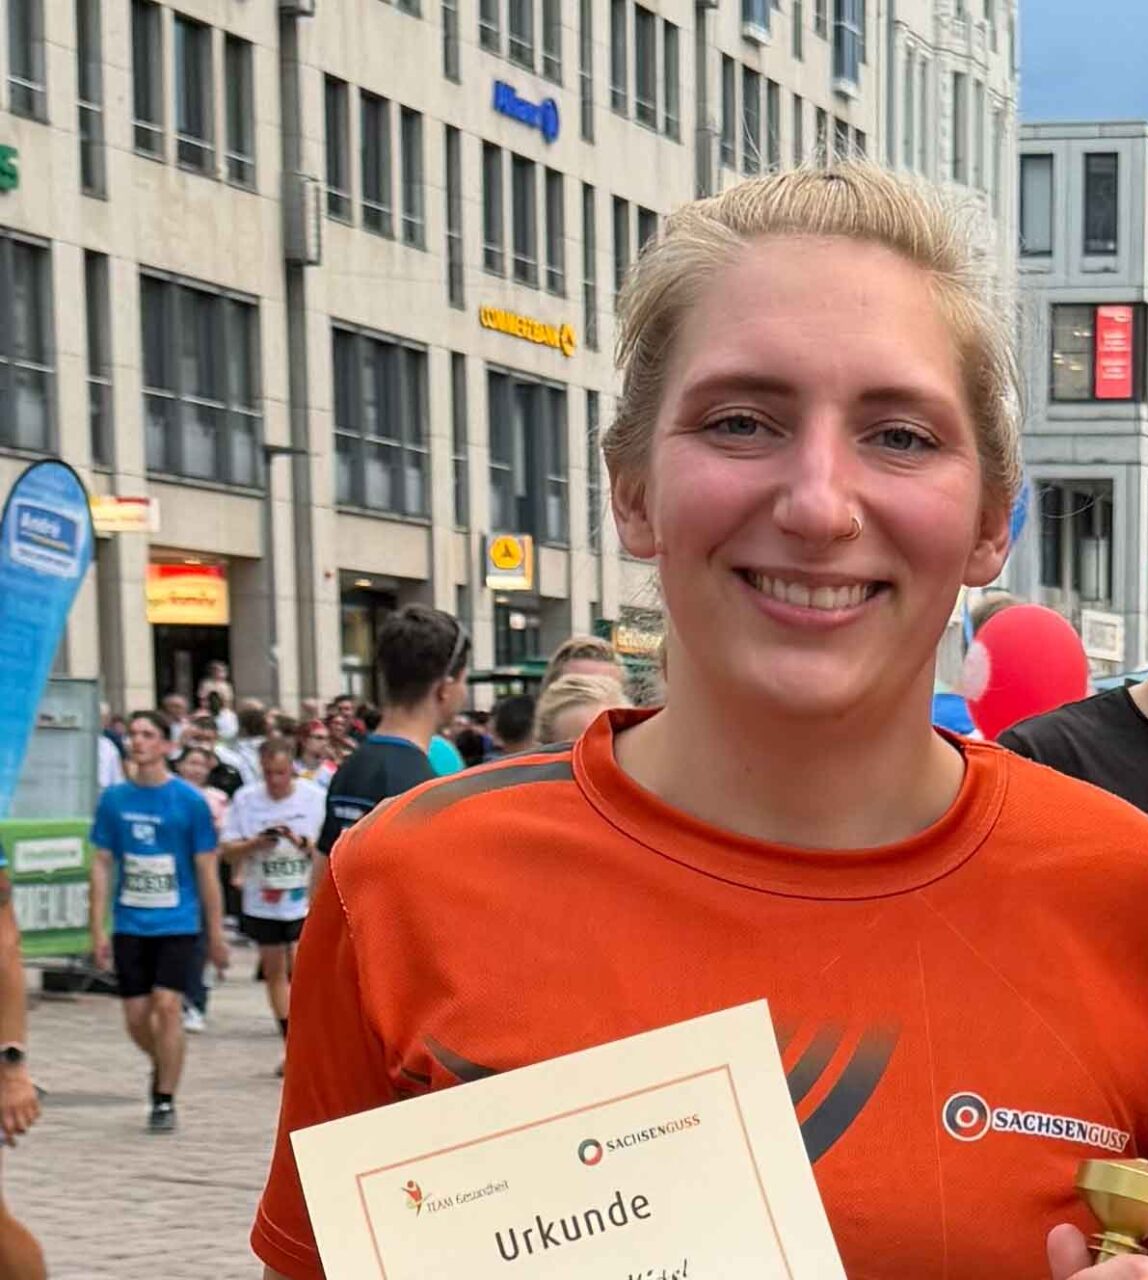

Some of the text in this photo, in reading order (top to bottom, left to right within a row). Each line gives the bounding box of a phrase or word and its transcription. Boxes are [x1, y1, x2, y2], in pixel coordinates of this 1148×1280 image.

[479, 306, 561, 348] COMMERZBANK
[606, 1114, 701, 1152] SACHSENGUSS
[994, 1110, 1128, 1151] SACHSENGUSS
[495, 1191, 651, 1261] Urkunde
